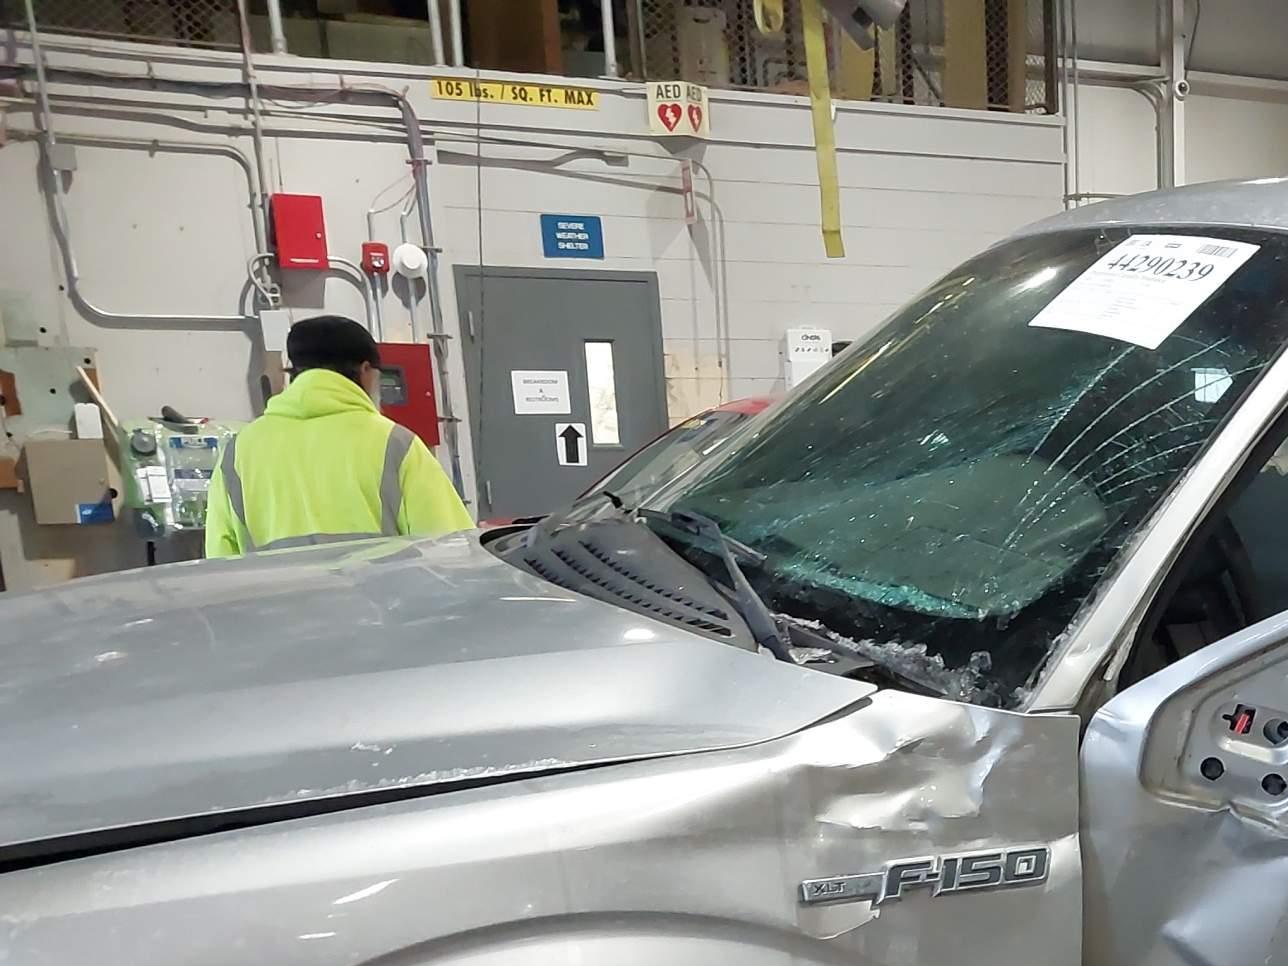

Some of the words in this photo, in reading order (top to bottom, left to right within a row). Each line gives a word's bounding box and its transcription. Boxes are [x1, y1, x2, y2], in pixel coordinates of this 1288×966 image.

[437, 80, 462, 97] 105
[469, 82, 494, 99] lbs.
[511, 87, 533, 103] SQ.
[539, 88, 558, 104] FT.
[564, 90, 594, 106] MAX
[656, 83, 681, 99] AED
[687, 85, 702, 101] AED
[1108, 254, 1214, 281] 44290239
[813, 880, 846, 896] XLT
[876, 847, 1051, 905] F-150
